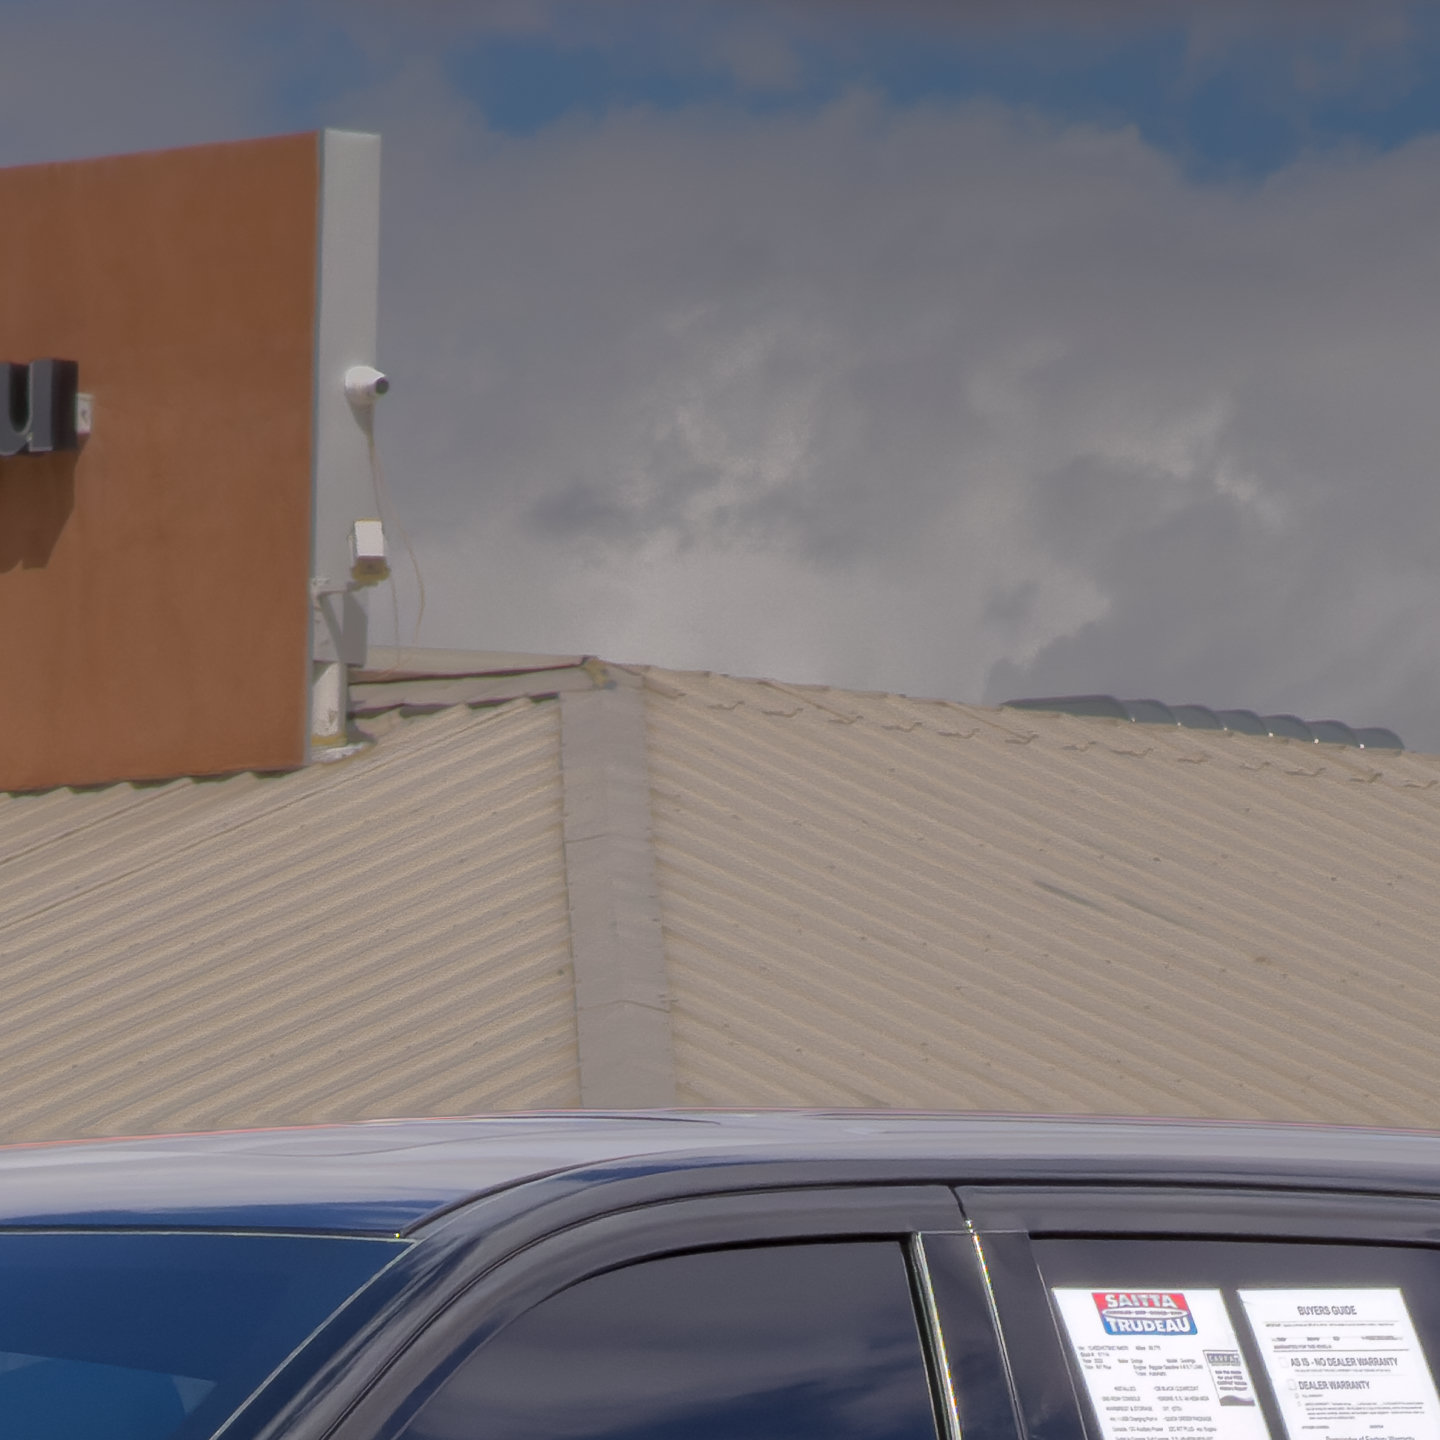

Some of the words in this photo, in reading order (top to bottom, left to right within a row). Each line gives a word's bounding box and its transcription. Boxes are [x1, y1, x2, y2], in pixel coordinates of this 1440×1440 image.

[1104, 1293, 1178, 1309] SAITTA
[1297, 1305, 1330, 1316] BUYERS
[1331, 1305, 1357, 1315] GUIDE
[1106, 1318, 1191, 1333] TRUDEAU
[1327, 1358, 1356, 1367] DEALER
[1357, 1357, 1398, 1367] WARRANTY
[1298, 1381, 1328, 1391] DEALER
[1329, 1380, 1370, 1390] WARRANTY
